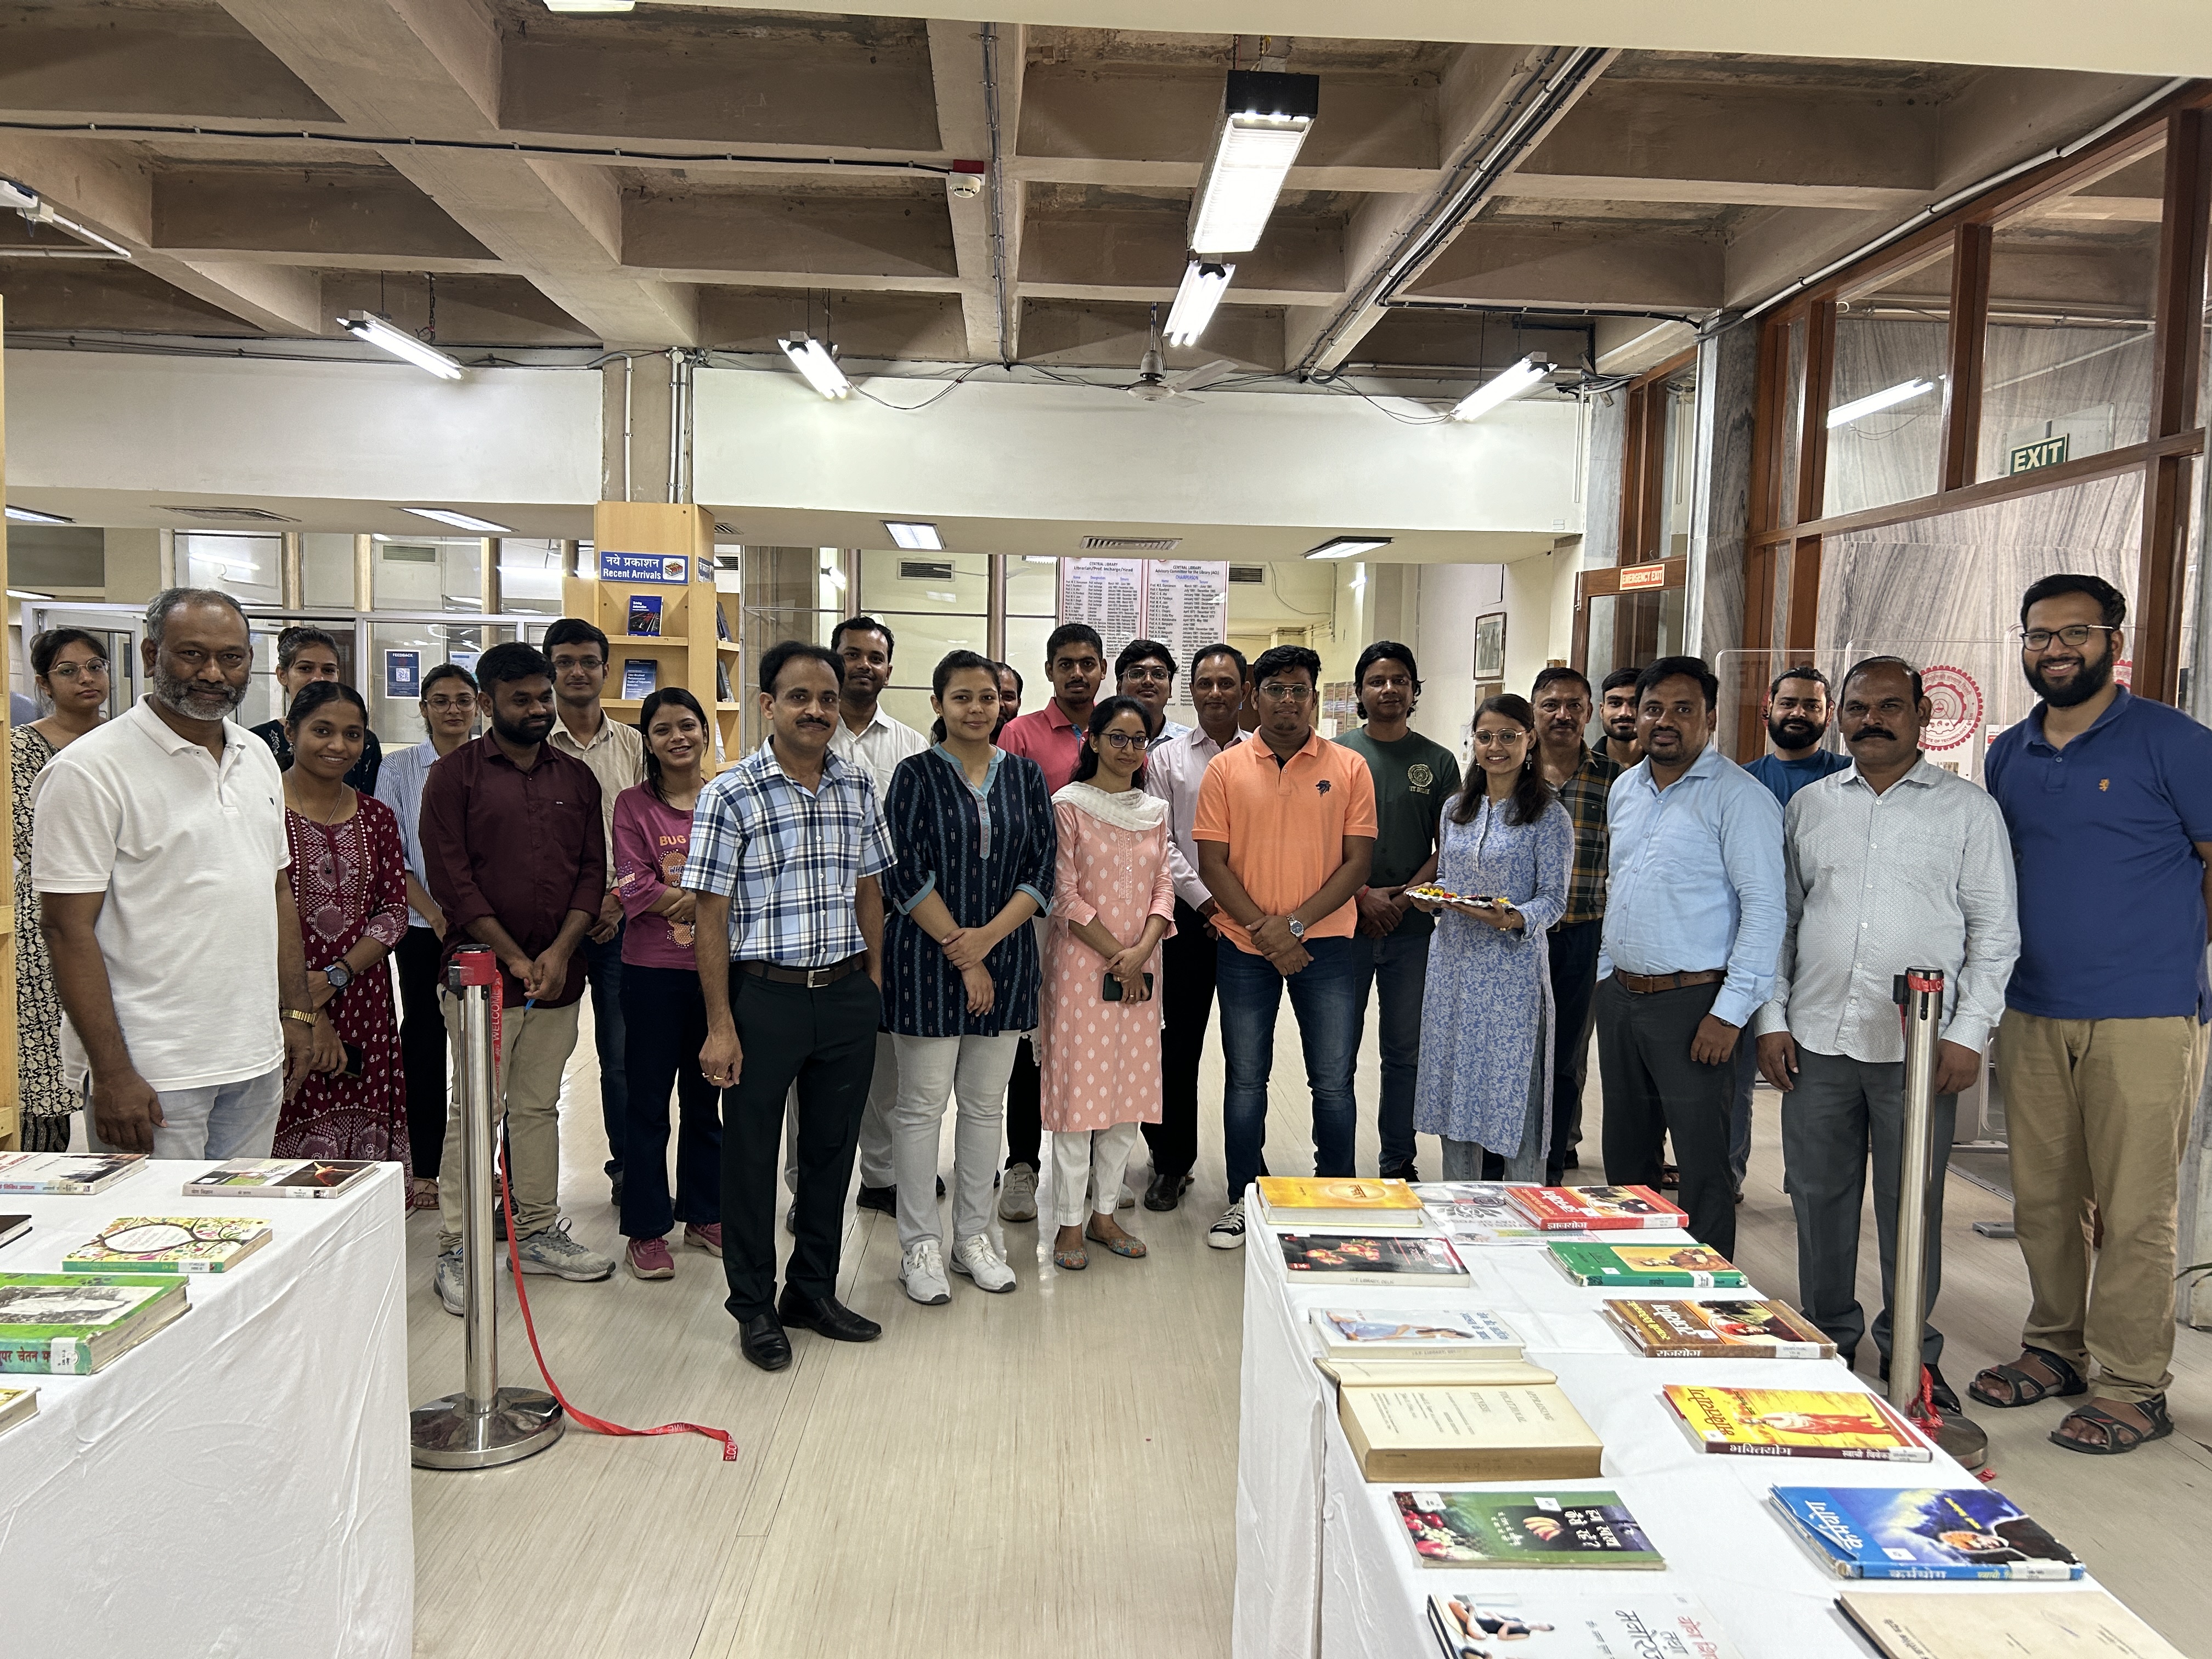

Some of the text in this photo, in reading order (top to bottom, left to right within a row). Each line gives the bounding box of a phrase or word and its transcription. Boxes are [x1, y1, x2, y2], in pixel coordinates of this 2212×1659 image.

[2013, 441, 2063, 472] EXIT
[605, 554, 659, 568] नये प्रकाशन
[603, 568, 661, 580] Recent Arrivals
[1622, 570, 1662, 584] EMERGENCY EXIT
[1940, 725, 1968, 743] TECHNOLOGY
[659, 834, 687, 847] BUG
[1539, 1190, 1580, 1213] ज्ञानयोग
[1547, 1220, 1588, 1229] ज्ञानयोग
[1652, 1304, 1695, 1335] राजयोग
[1649, 1323, 1670, 1340] स्वामी
[16, 1346, 38, 1363] चेतन
[1656, 1347, 1701, 1357] राजयोग
[1469, 1392, 1492, 1413] FITNESS
[1524, 1390, 1555, 1420] APPRAISING
[1687, 1388, 1736, 1436] भक्तियोग
[1729, 1442, 1792, 1455] भक्तियोग
[1842, 1449, 1864, 1458] स्वामी
[1584, 1510, 1604, 1522] हम
[1805, 1500, 1864, 1550] कर्मयोग
[1888, 1566, 1947, 1579] कर्मयोग
